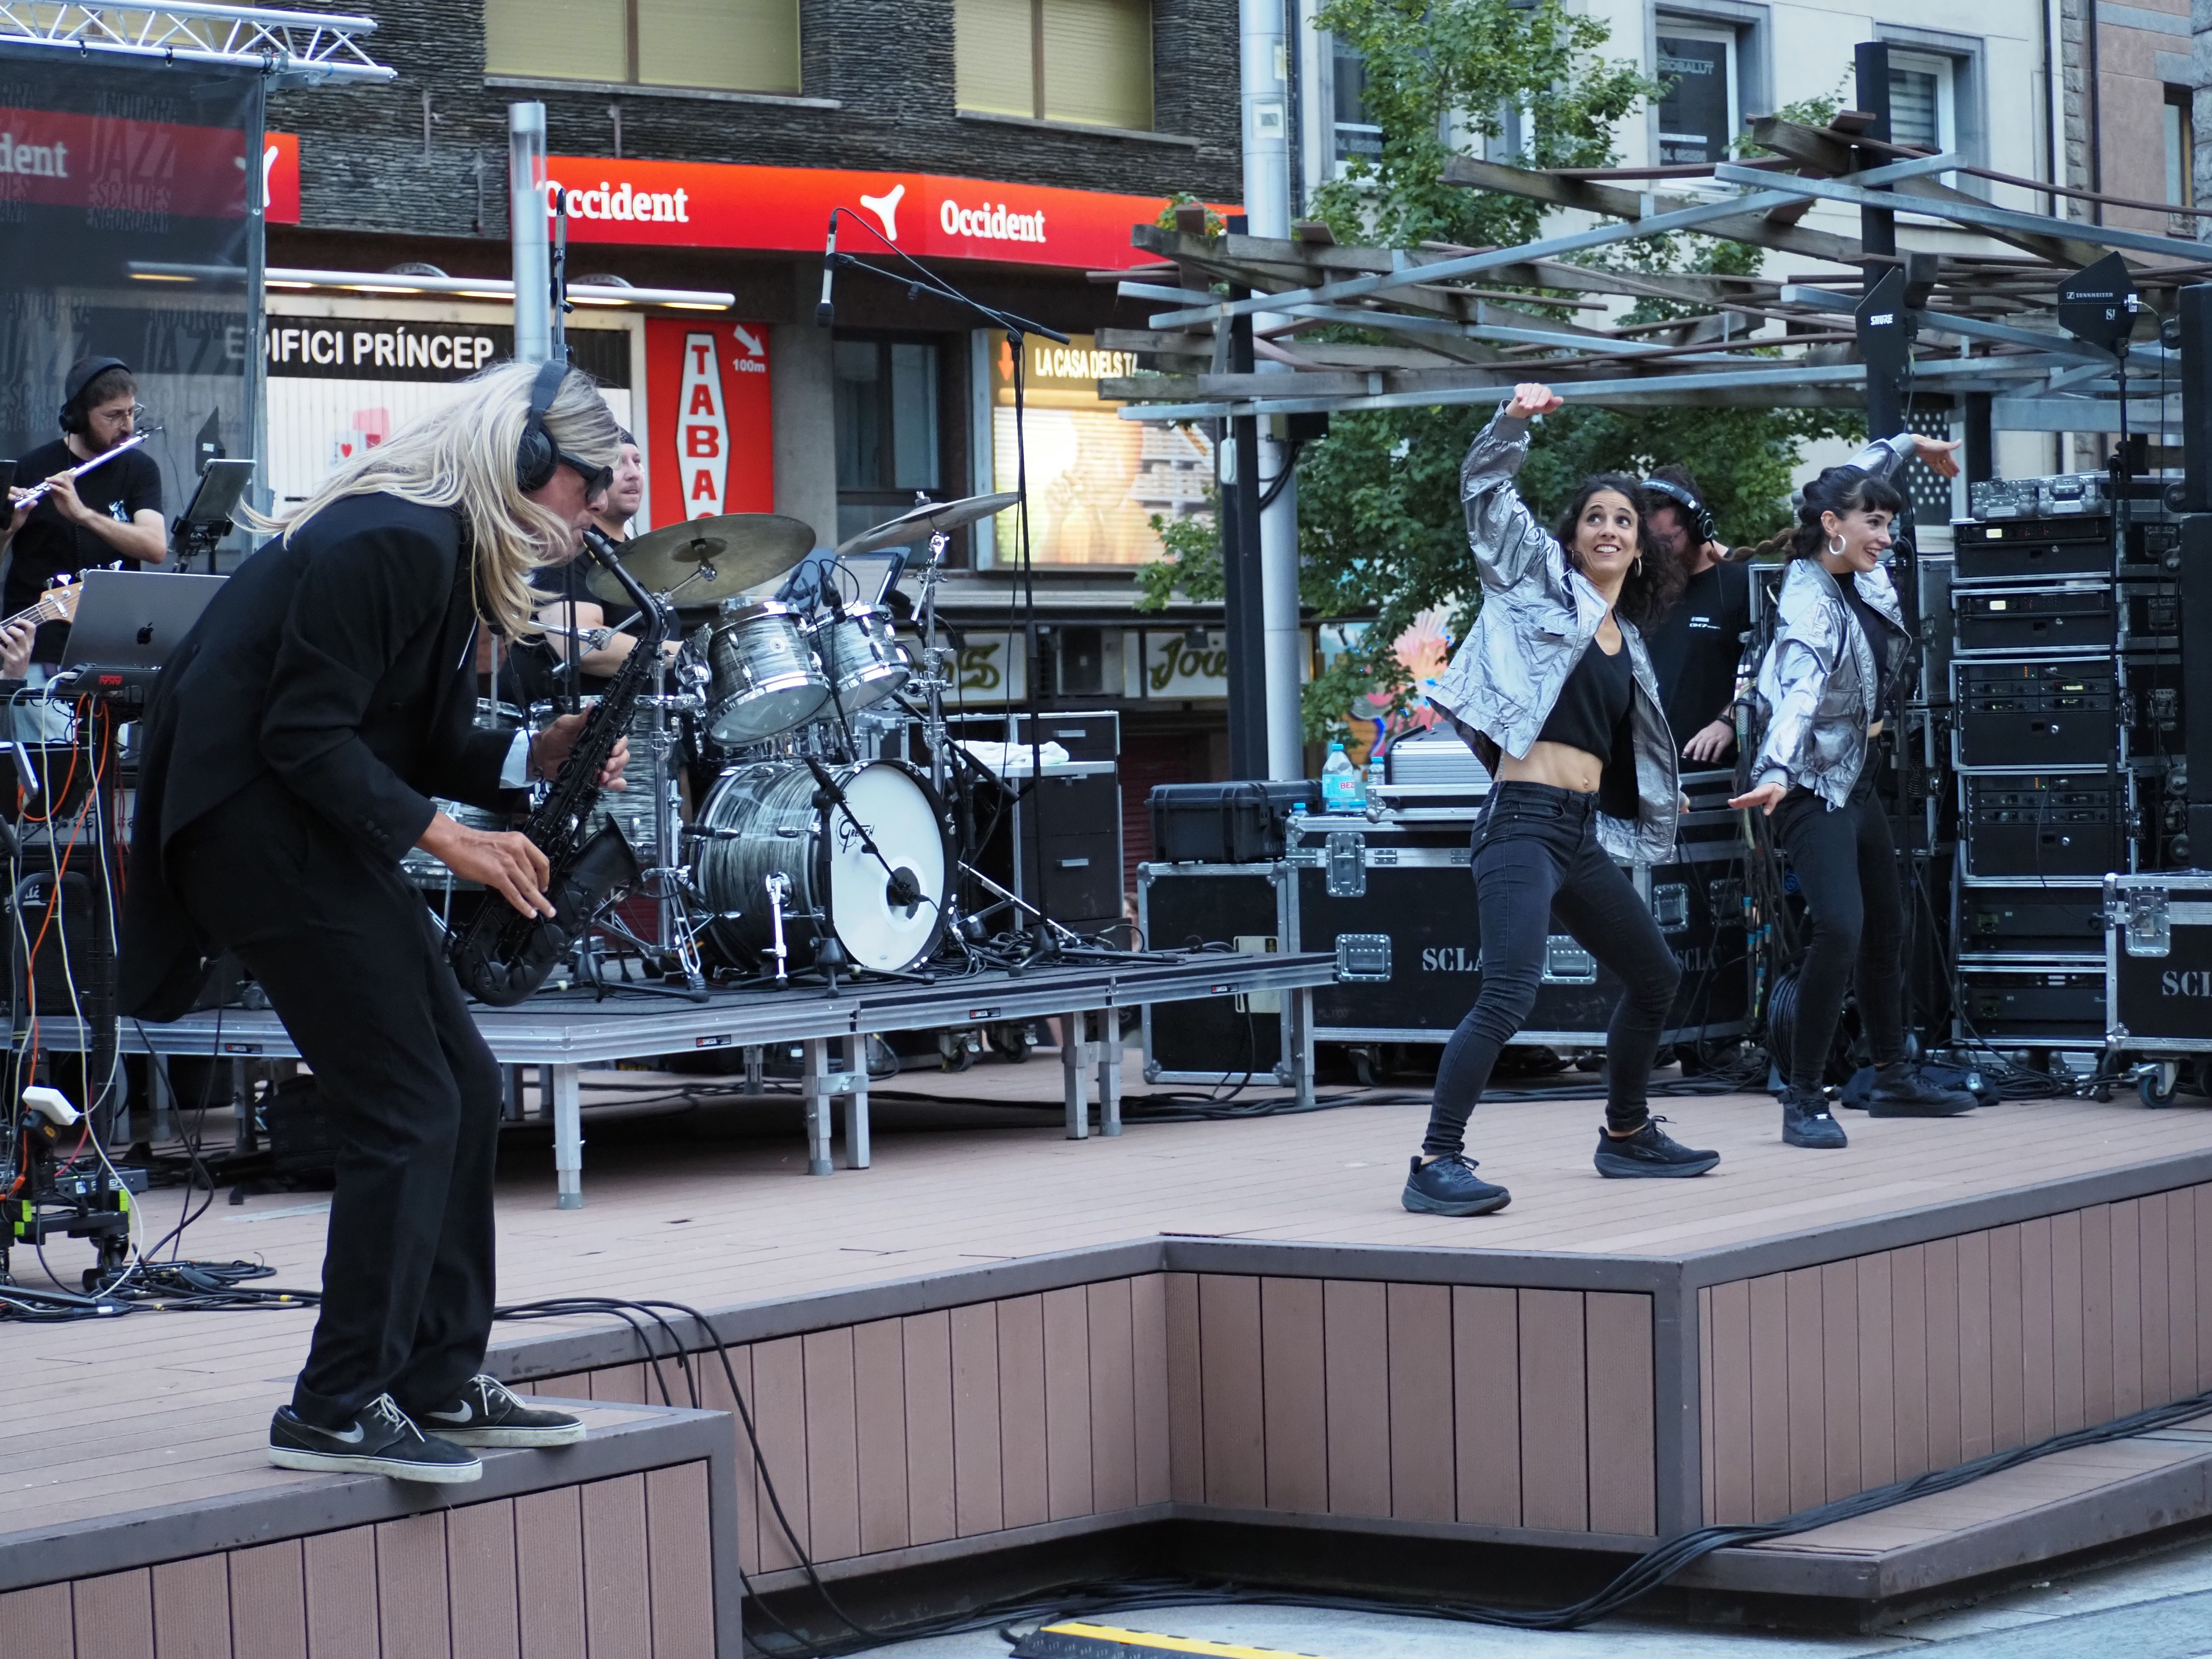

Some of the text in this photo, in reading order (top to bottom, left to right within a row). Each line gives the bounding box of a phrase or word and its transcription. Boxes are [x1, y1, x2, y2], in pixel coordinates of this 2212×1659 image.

[535, 180, 689, 223] Occident
[940, 200, 1046, 243] Occident
[1871, 314, 1893, 326] SHURE
[353, 327, 494, 370] PRÍNCEP
[733, 359, 766, 373] 100m
[1035, 347, 1054, 377] LA
[1054, 348, 1090, 378] CASA
[1090, 350, 1123, 379] DELS
